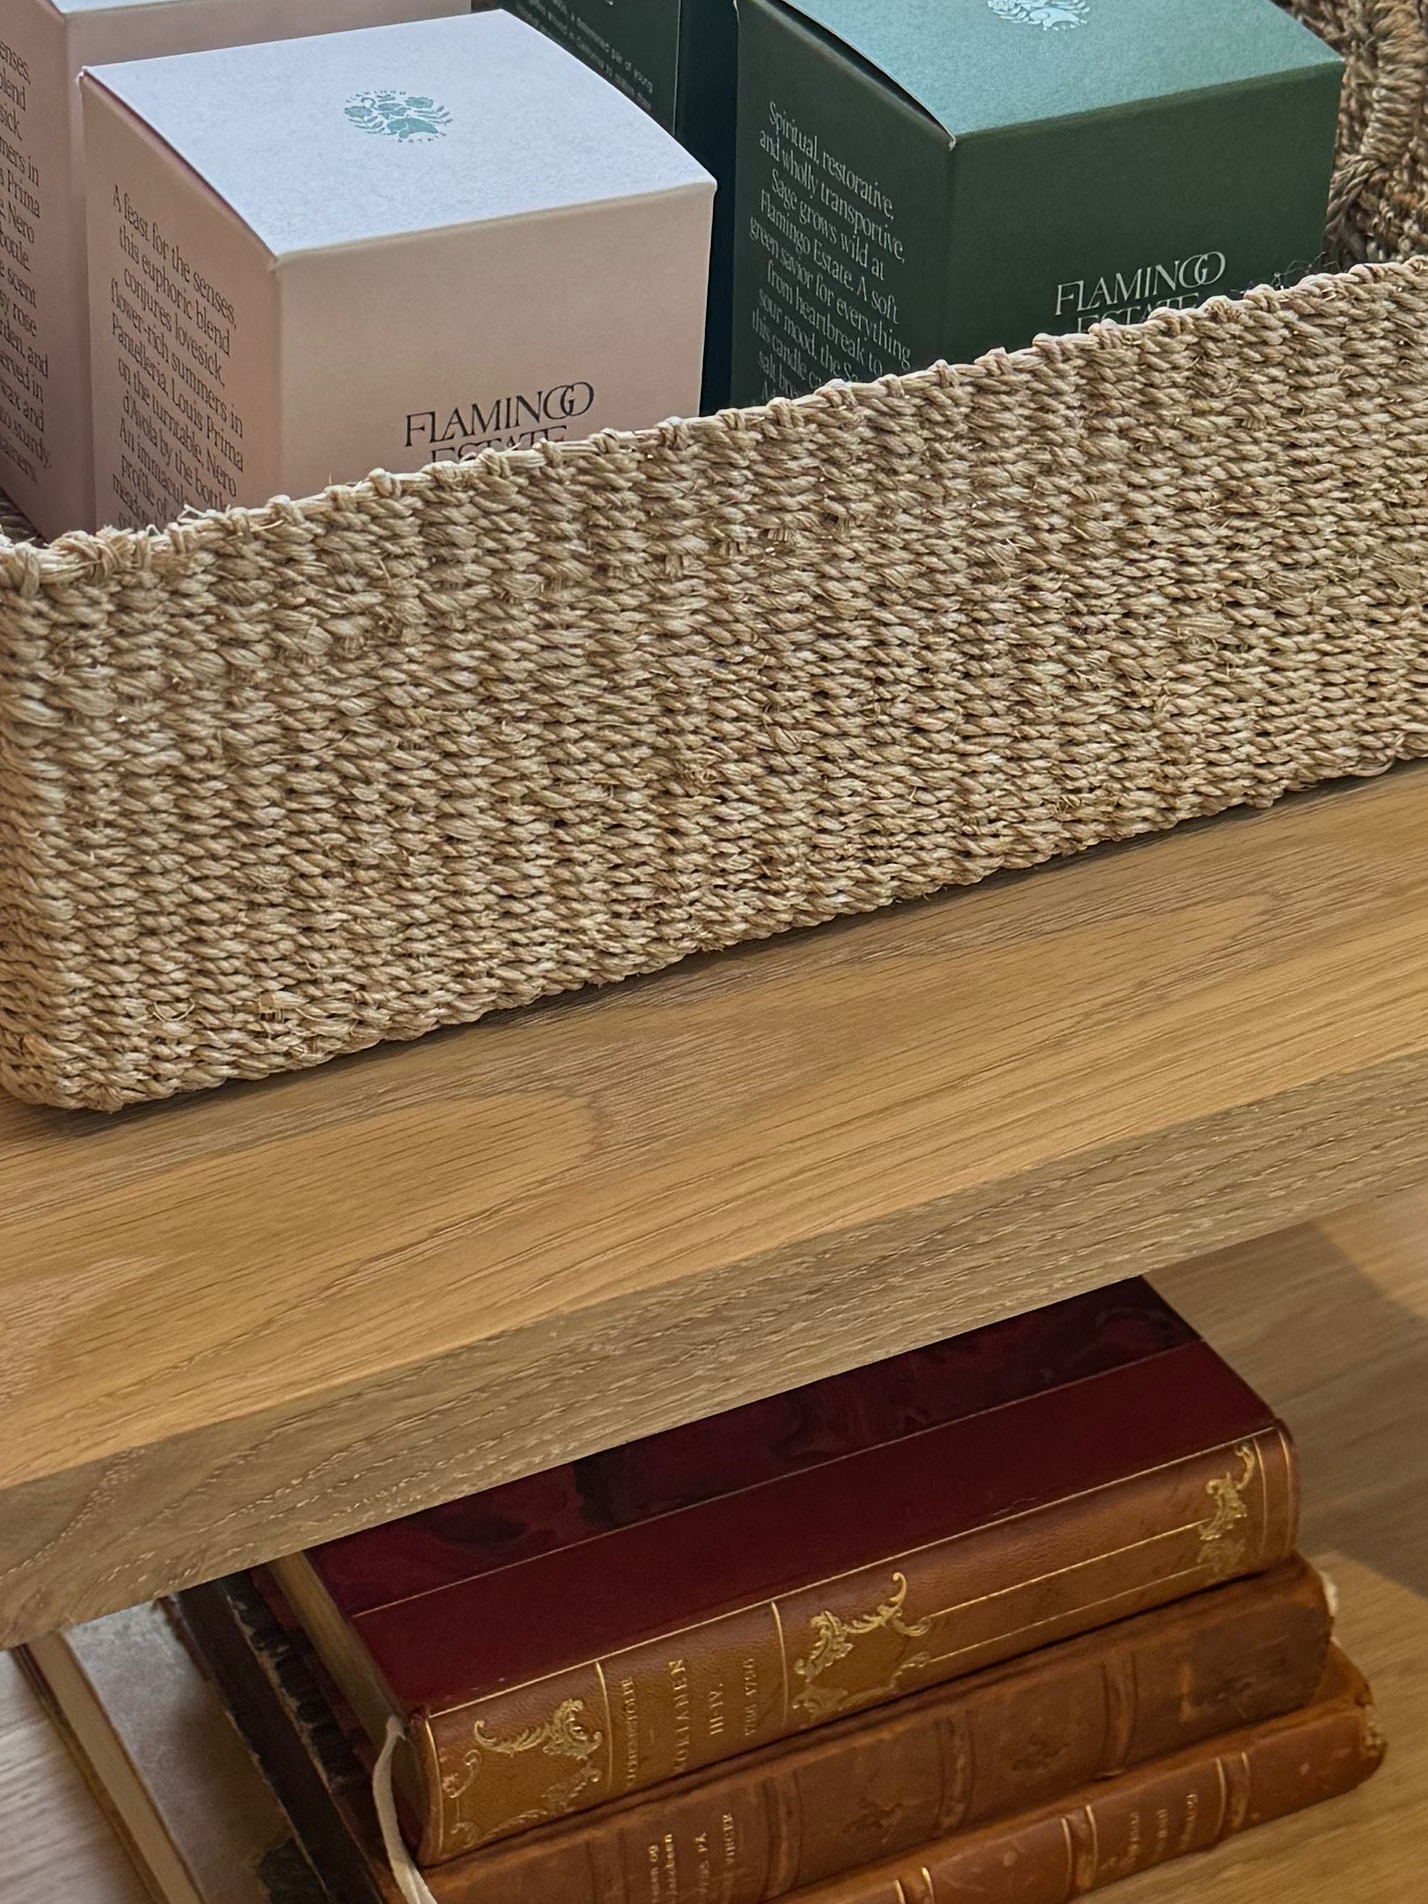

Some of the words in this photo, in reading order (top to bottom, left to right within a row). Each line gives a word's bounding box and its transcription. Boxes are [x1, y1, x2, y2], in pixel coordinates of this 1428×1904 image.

[7, 168, 41, 219] Prima
[28, 155, 40, 188] in
[759, 130, 780, 163] and
[782, 149, 820, 200] wholly
[821, 182, 905, 264] transportive,
[822, 150, 895, 223] restorative,
[8, 200, 35, 244] Nero
[772, 168, 798, 210] Sage
[799, 200, 838, 245] grows
[840, 231, 869, 270] wild
[871, 257, 885, 282] at
[7, 267, 37, 309] scent
[113, 184, 122, 213] A
[123, 192, 150, 243] feast
[152, 222, 170, 261] for
[172, 244, 191, 284] the
[193, 271, 238, 332] senses,
[760, 188, 811, 256] Flamingo
[856, 275, 868, 302] A
[871, 290, 899, 325] soft
[1054, 250, 1227, 316] FLAMINGO
[12, 303, 37, 337] rose
[119, 224, 140, 265] this
[141, 253, 193, 321] euphoric
[195, 298, 231, 358] blend
[124, 267, 173, 333] conjures
[749, 216, 780, 259] green
[780, 247, 814, 290] savior
[815, 273, 835, 307] for
[836, 297, 911, 371] everything
[767, 259, 793, 305] from
[795, 286, 866, 366] heartbreak
[868, 352, 884, 377] to
[27, 346, 49, 379] and
[111, 277, 170, 364] flower-rich
[171, 351, 228, 423] summers
[230, 403, 244, 439] in
[752, 307, 771, 344] this
[771, 334, 807, 382] candle
[758, 288, 783, 325] sour
[820, 343, 842, 378] the
[24, 403, 45, 433] and
[32, 374, 44, 404] in
[403, 381, 596, 448] FLAMINGO
[118, 357, 132, 386] on
[133, 370, 151, 407] the
[206, 447, 238, 498] Nero
[119, 417, 135, 453] An
[159, 427, 174, 468] by
[174, 449, 193, 486] the
[171, 377, 204, 432] Louis
[206, 414, 245, 474] Prima
[156, 496, 169, 521] of
